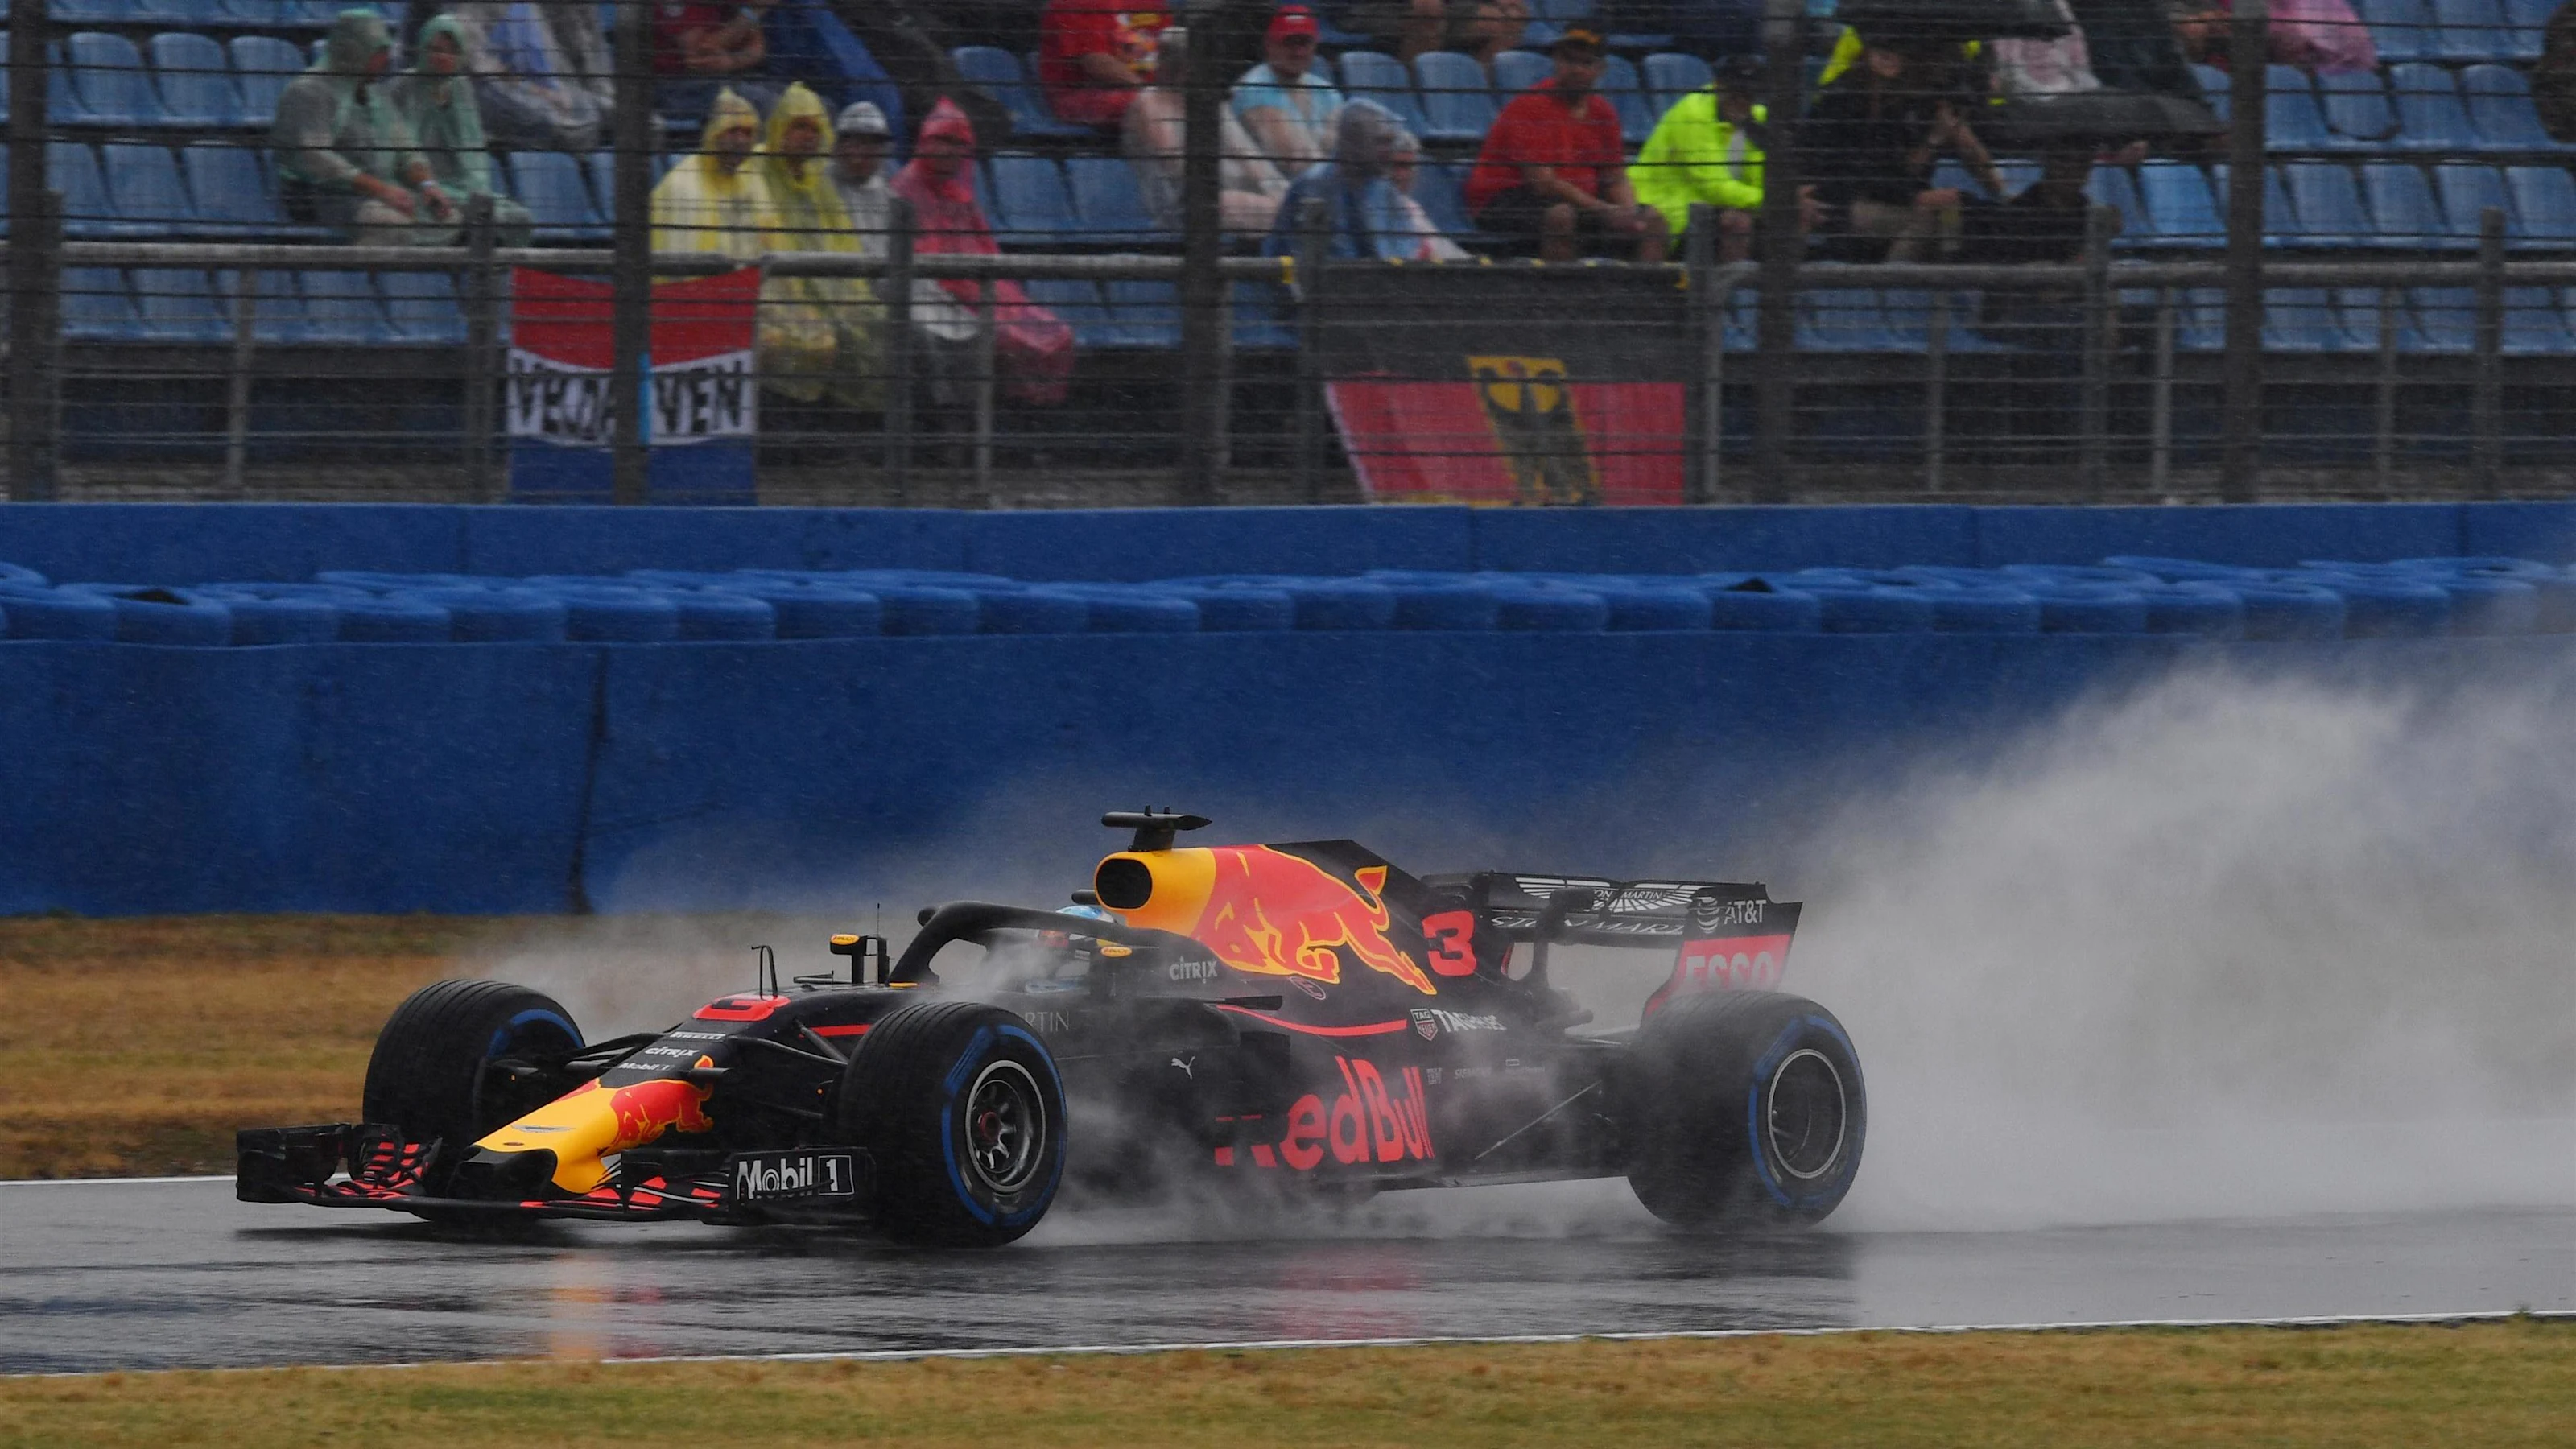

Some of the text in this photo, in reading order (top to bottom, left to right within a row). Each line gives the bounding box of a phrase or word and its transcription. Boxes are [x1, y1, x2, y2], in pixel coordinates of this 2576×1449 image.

[1724, 900, 1767, 925] AT&T
[1422, 910, 1477, 976] 3
[1025, 1011, 1070, 1032] RTIN
[1414, 1012, 1431, 1021] TAG
[618, 1063, 659, 1071] Mobil
[1214, 1055, 1435, 1170] edBull
[737, 1157, 838, 1201] Mobil 1
